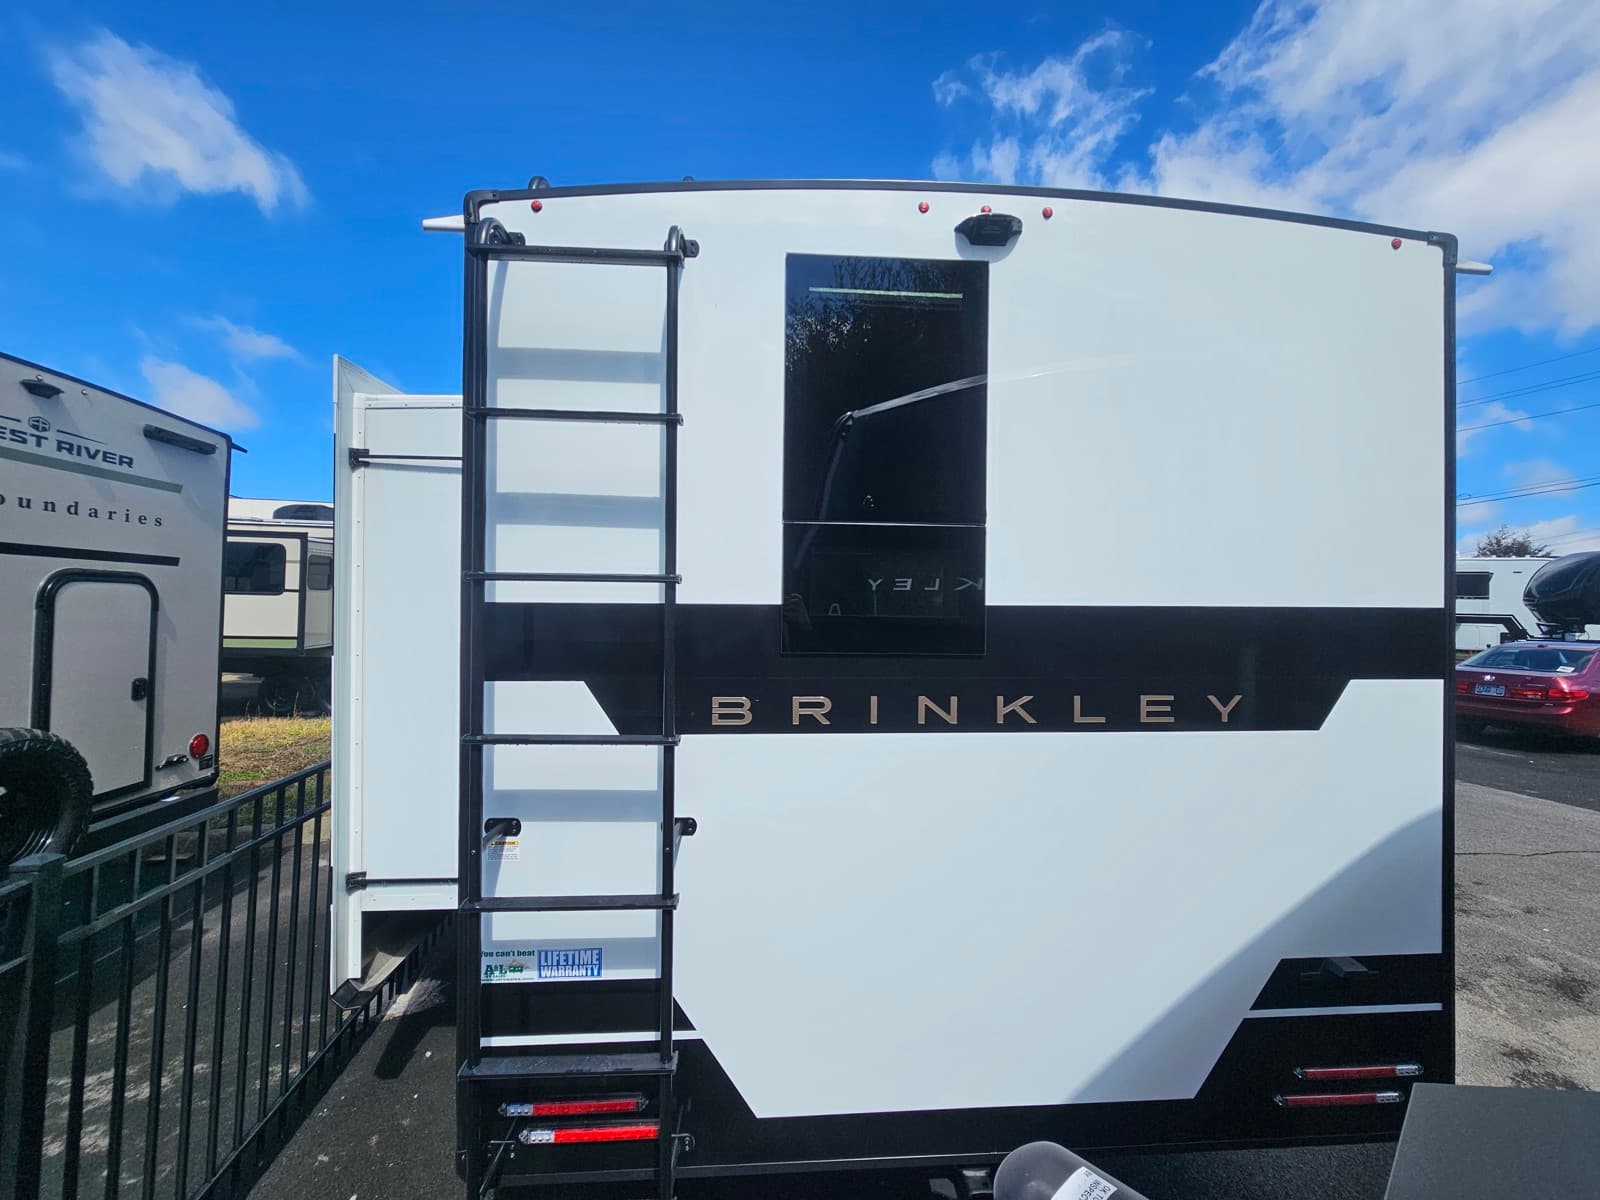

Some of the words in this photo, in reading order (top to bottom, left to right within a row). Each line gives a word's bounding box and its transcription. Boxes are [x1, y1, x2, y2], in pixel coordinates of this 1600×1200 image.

[56, 440, 134, 469] RIVER
[711, 694, 1243, 726] BRINKLEY
[541, 950, 600, 966] LIFETIME
[540, 965, 600, 978] WARRANTY
